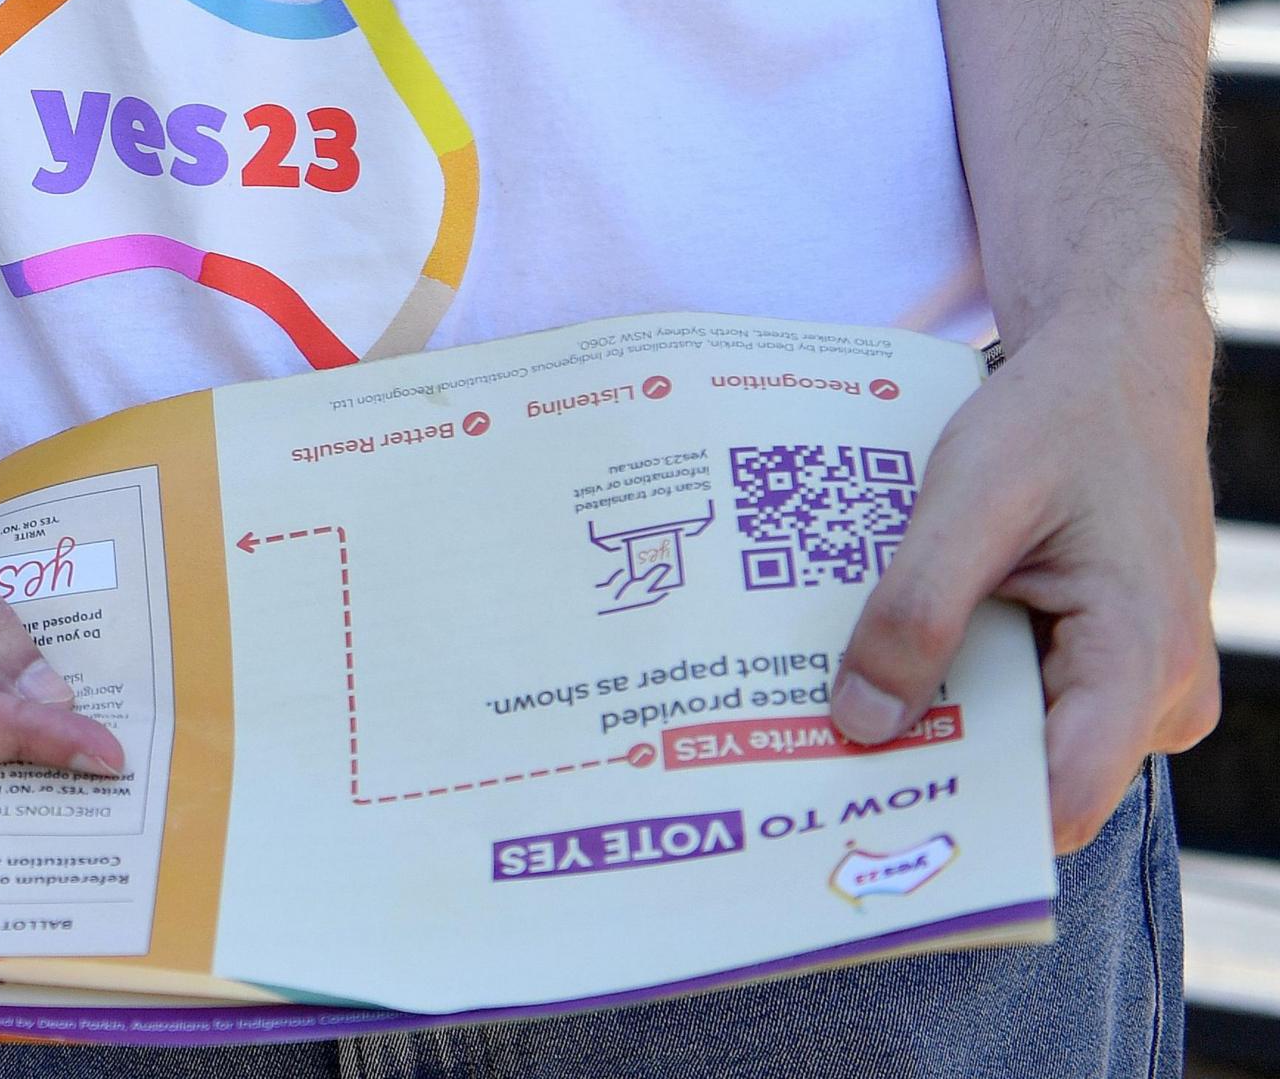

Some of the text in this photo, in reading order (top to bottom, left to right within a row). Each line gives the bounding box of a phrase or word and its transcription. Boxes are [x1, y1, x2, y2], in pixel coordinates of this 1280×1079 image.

[620, 330, 653, 343] NSW
[656, 327, 706, 339] Sydney
[627, 340, 703, 357] Australians
[759, 342, 795, 352] Dean
[799, 341, 815, 354] by
[605, 348, 625, 361] for
[531, 351, 603, 375] Indigenous
[437, 367, 529, 394] Constitutional
[711, 374, 861, 396] Recognition
[357, 384, 434, 405] Recognition
[329, 398, 354, 411] Ltd.
[527, 385, 634, 420] Listening
[291, 422, 454, 464] Better Results
[608, 449, 708, 475] yes23.com.au
[573, 466, 710, 500] information or visit
[574, 481, 711, 514] Scan for translated
[22, 520, 38, 530] OR
[13, 529, 46, 542] WRITE
[42, 609, 103, 631] proposed
[56, 628, 80, 644] you
[83, 628, 101, 640] Do
[486, 653, 829, 716] ballot paper as shown.
[600, 682, 830, 734] pace provided
[675, 728, 835, 763] write YES
[6, 770, 70, 781] opposite
[39, 785, 54, 795] or
[92, 786, 131, 797] Write
[16, 805, 112, 818] DIRECTIONS
[497, 776, 959, 876] HOW TO VOTE YES
[7, 855, 121, 868] Constitution
[16, 874, 130, 887] Referendum
[2, 919, 73, 931] BALLOT
